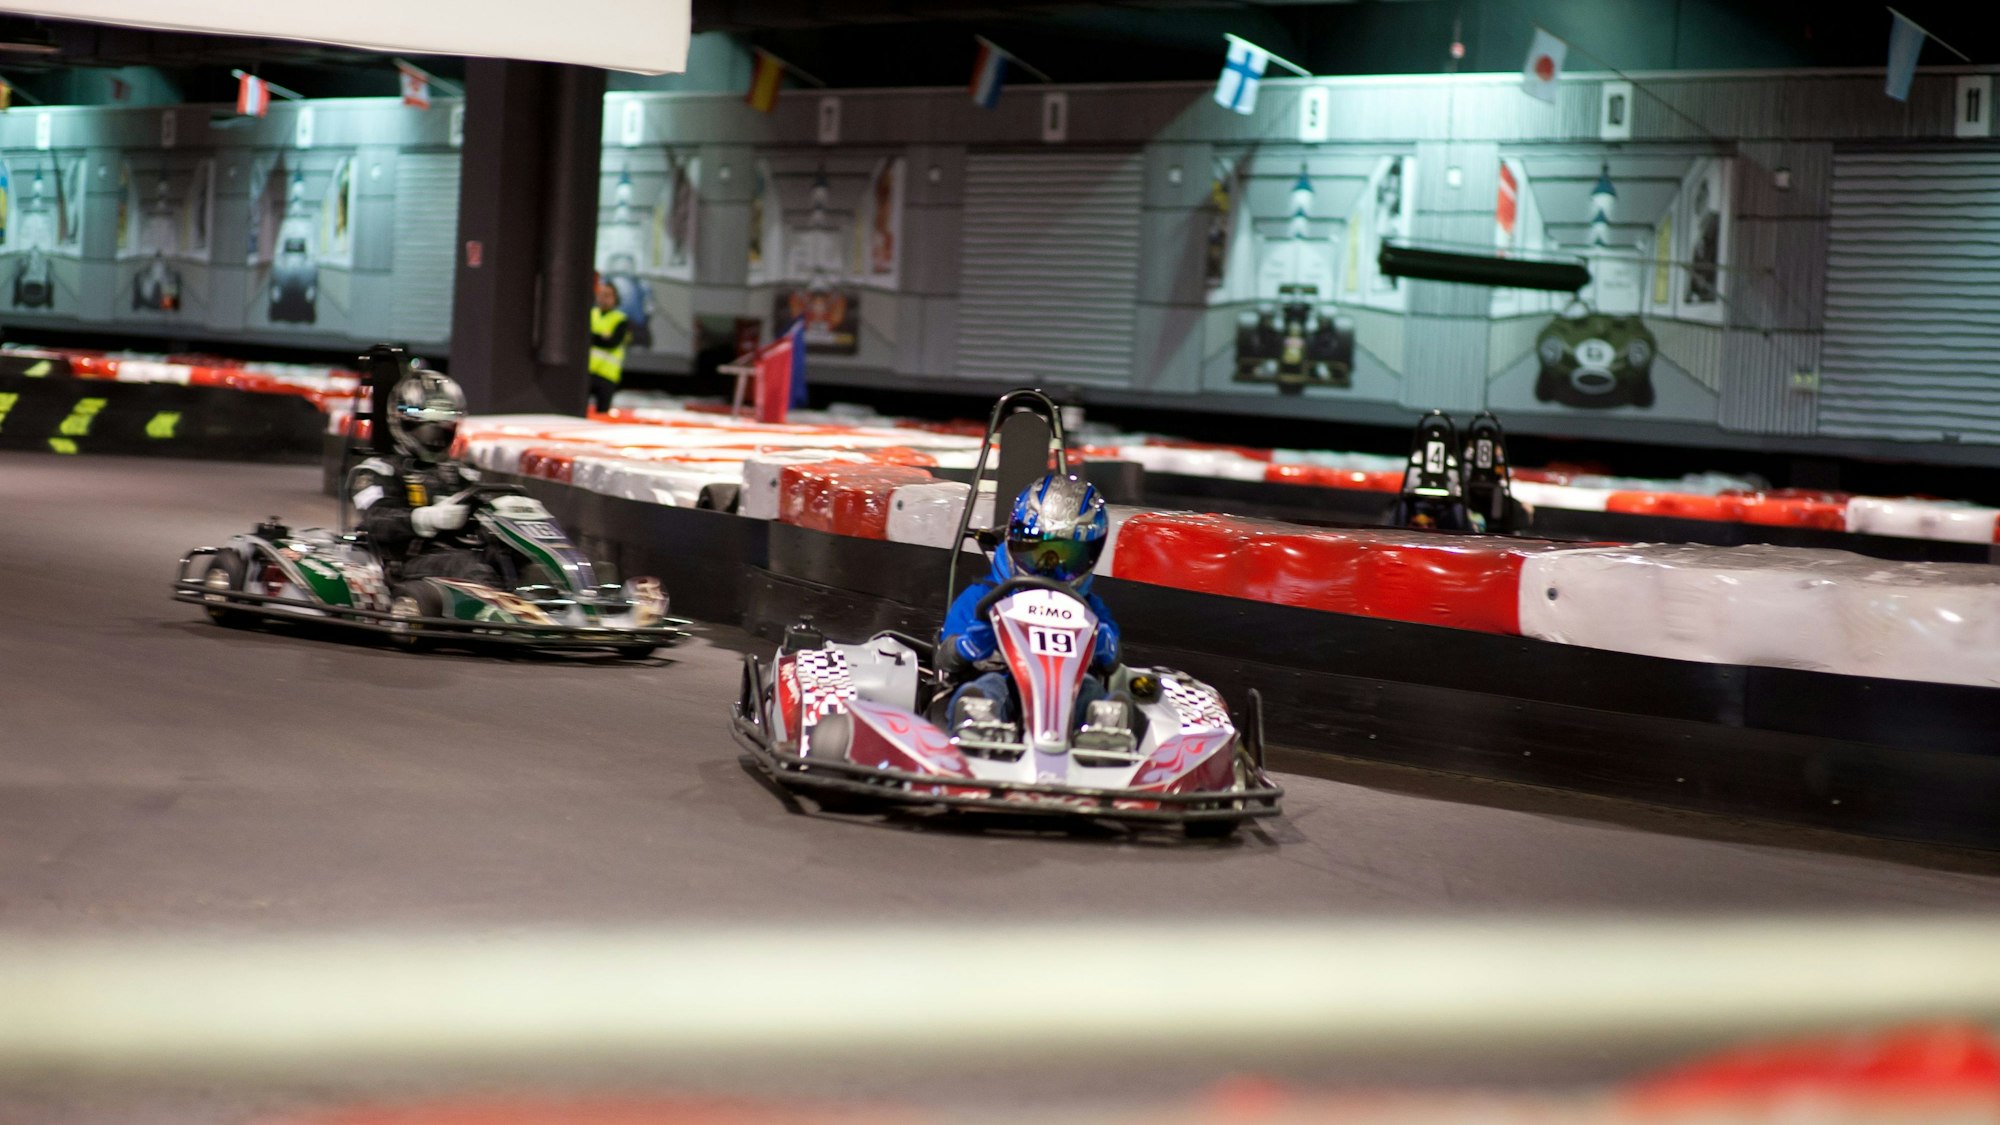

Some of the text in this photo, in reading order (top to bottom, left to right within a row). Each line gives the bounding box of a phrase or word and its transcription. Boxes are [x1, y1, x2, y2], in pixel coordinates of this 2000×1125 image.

[1966, 87, 1980, 122] 11
[1431, 445, 1442, 469] 4
[1480, 442, 1491, 463] 8
[1033, 631, 1072, 653] 19
